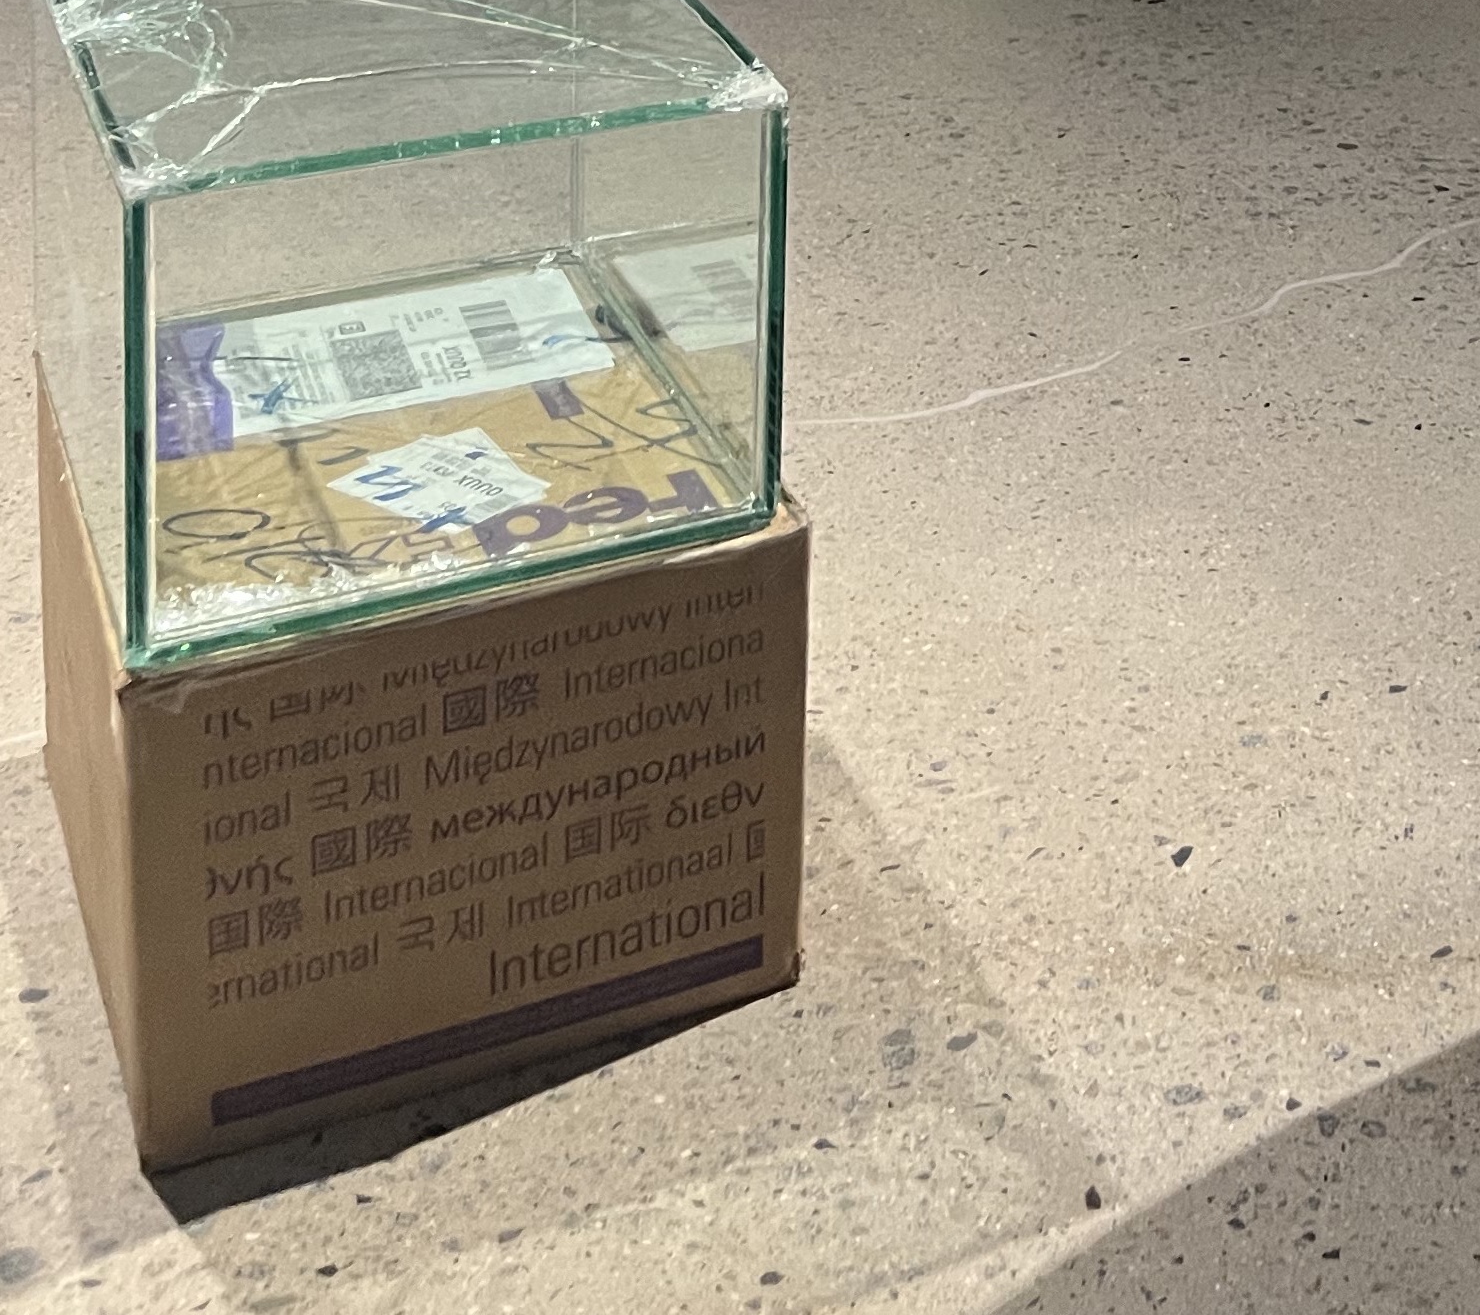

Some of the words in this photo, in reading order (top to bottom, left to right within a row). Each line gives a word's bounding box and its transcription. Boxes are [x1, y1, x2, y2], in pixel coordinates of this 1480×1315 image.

[442, 671, 541, 737] 國際
[563, 627, 764, 701] Internaciona
[307, 763, 400, 813] 국제
[424, 691, 714, 790] Międzynarodowy
[724, 675, 764, 712] Int
[311, 812, 412, 877] 國際
[431, 726, 766, 844] международный
[324, 830, 548, 925] Internacional
[396, 900, 484, 951] 국제
[507, 831, 733, 929] Internationaal
[489, 871, 765, 997] International
